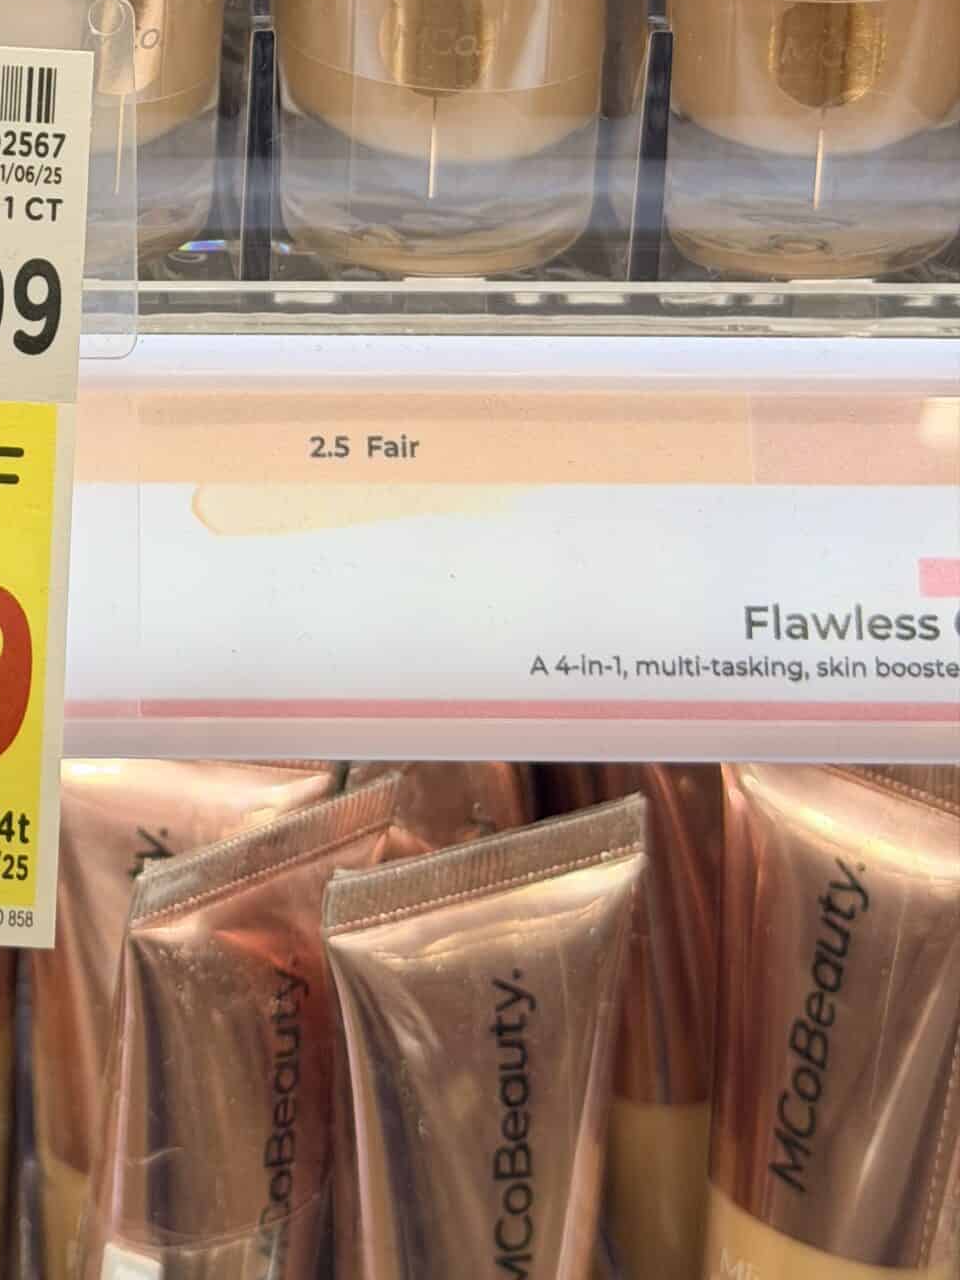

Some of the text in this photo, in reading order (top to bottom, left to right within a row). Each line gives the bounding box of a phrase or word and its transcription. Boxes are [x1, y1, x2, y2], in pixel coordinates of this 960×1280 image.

[3, 194, 15, 221] 1
[24, 196, 64, 223] CT
[308, 433, 421, 460] 2.5 Fair
[743, 603, 941, 642] Flawless
[529, 654, 550, 677] A
[554, 653, 629, 681] 4-in-1,
[635, 654, 811, 683] multi-tasking,
[815, 655, 868, 678] skin
[7, 909, 35, 929] 858
[768, 857, 870, 1194] MCoBeauty.
